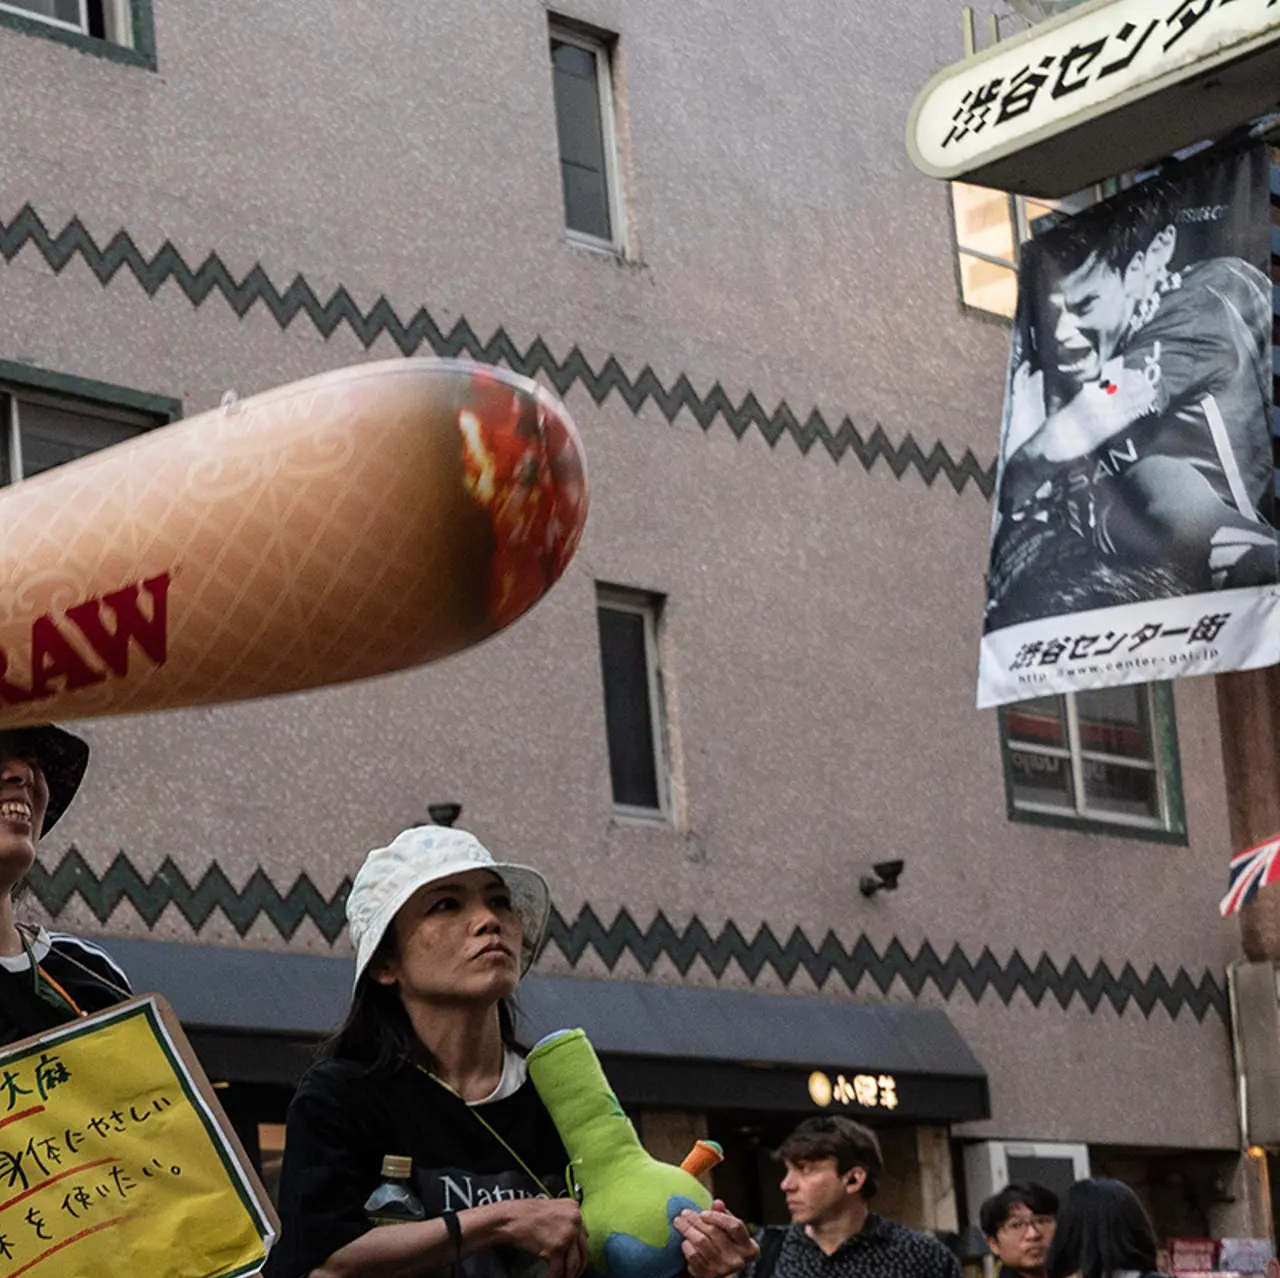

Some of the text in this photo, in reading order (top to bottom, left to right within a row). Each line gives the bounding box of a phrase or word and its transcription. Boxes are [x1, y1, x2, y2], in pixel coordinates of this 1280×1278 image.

[941, 0, 1240, 148] 渋谷センタ
[1008, 612, 1231, 672] 渋谷センター街
